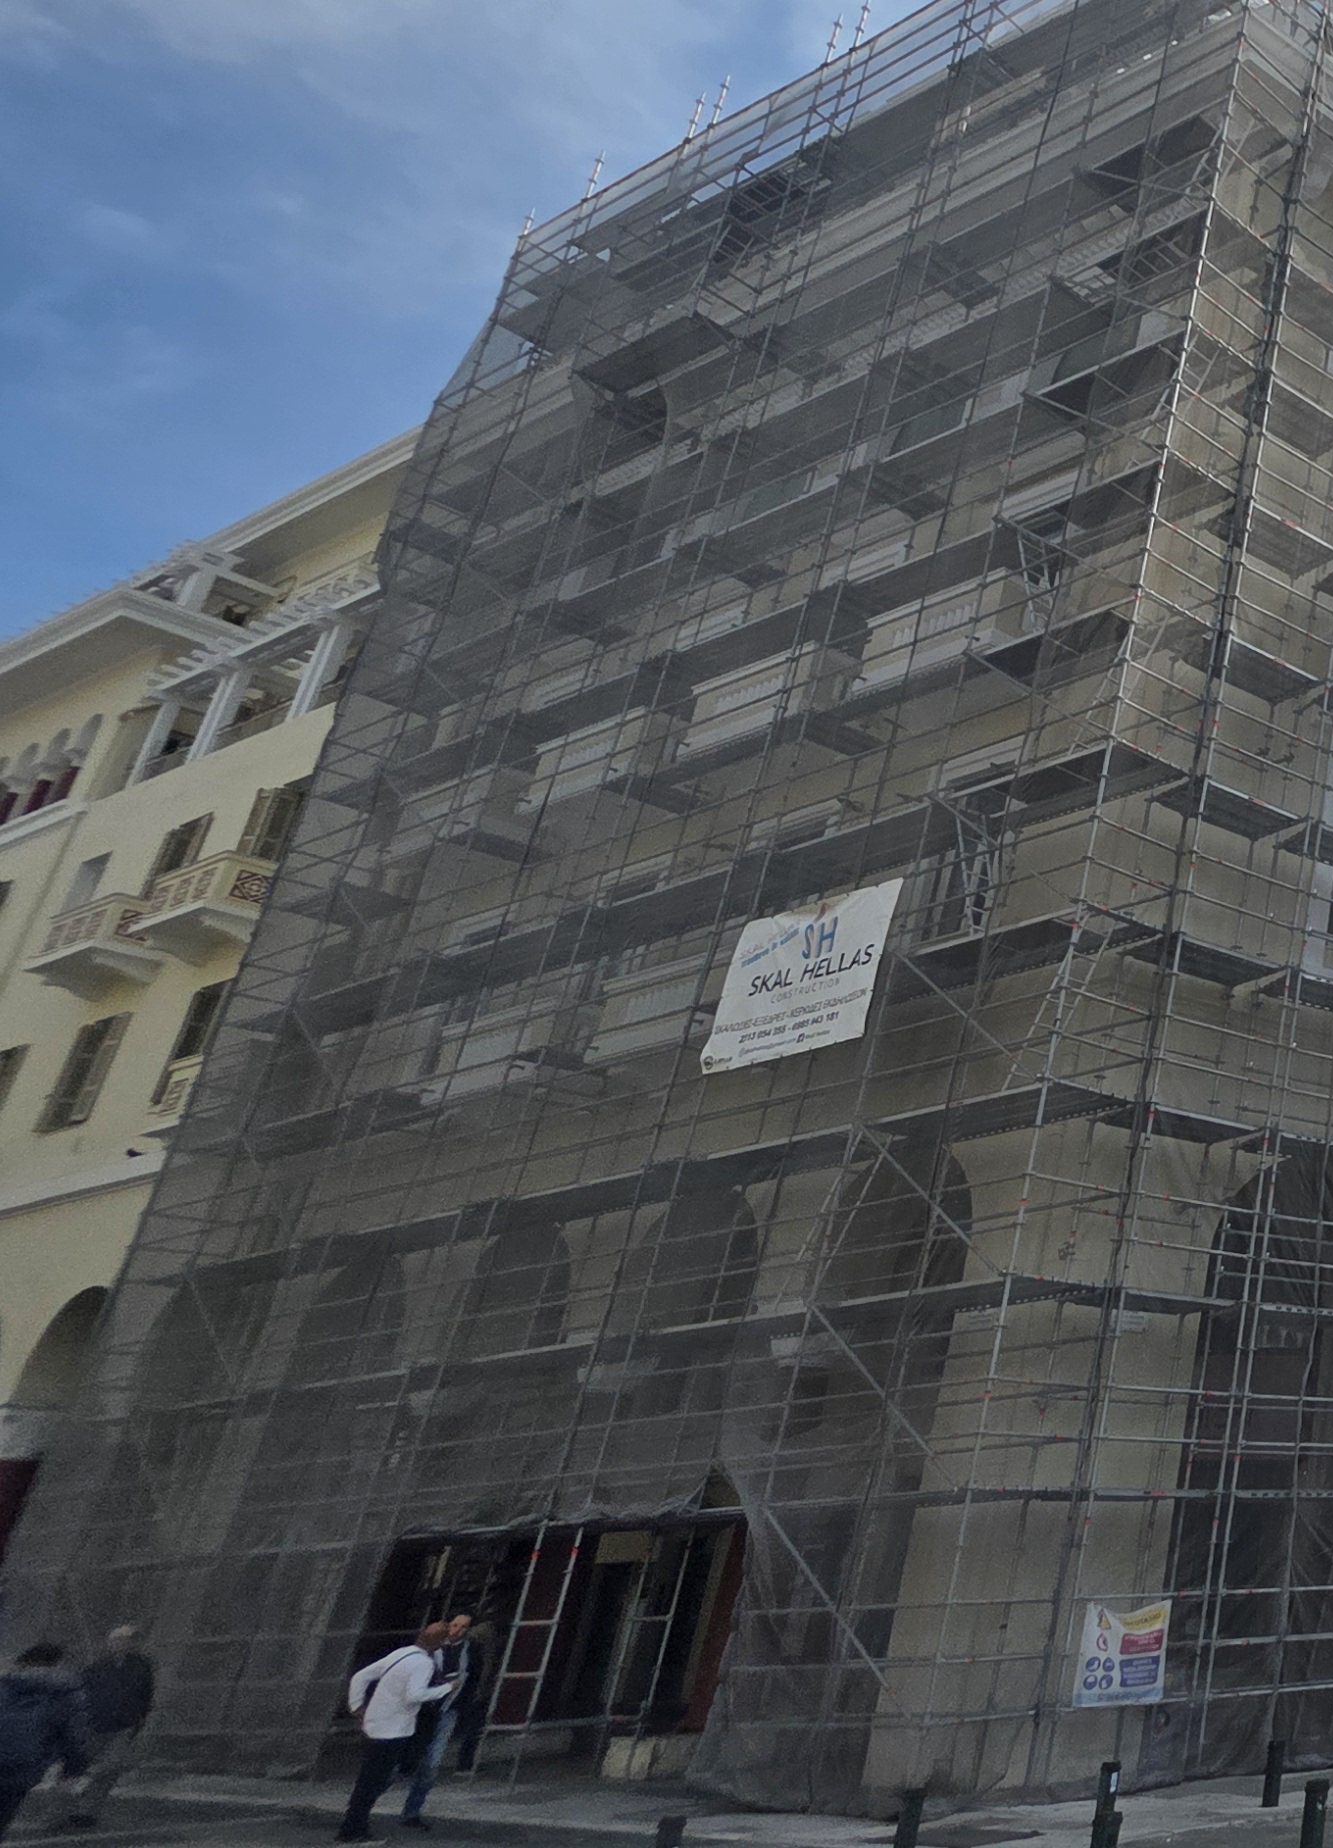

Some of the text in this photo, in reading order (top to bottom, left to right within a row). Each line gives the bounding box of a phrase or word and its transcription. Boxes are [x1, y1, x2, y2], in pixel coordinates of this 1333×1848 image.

[748, 968, 793, 997] SKAL
[800, 944, 875, 983] HELLAS
[770, 977, 841, 1004] CONSTRUCTION
